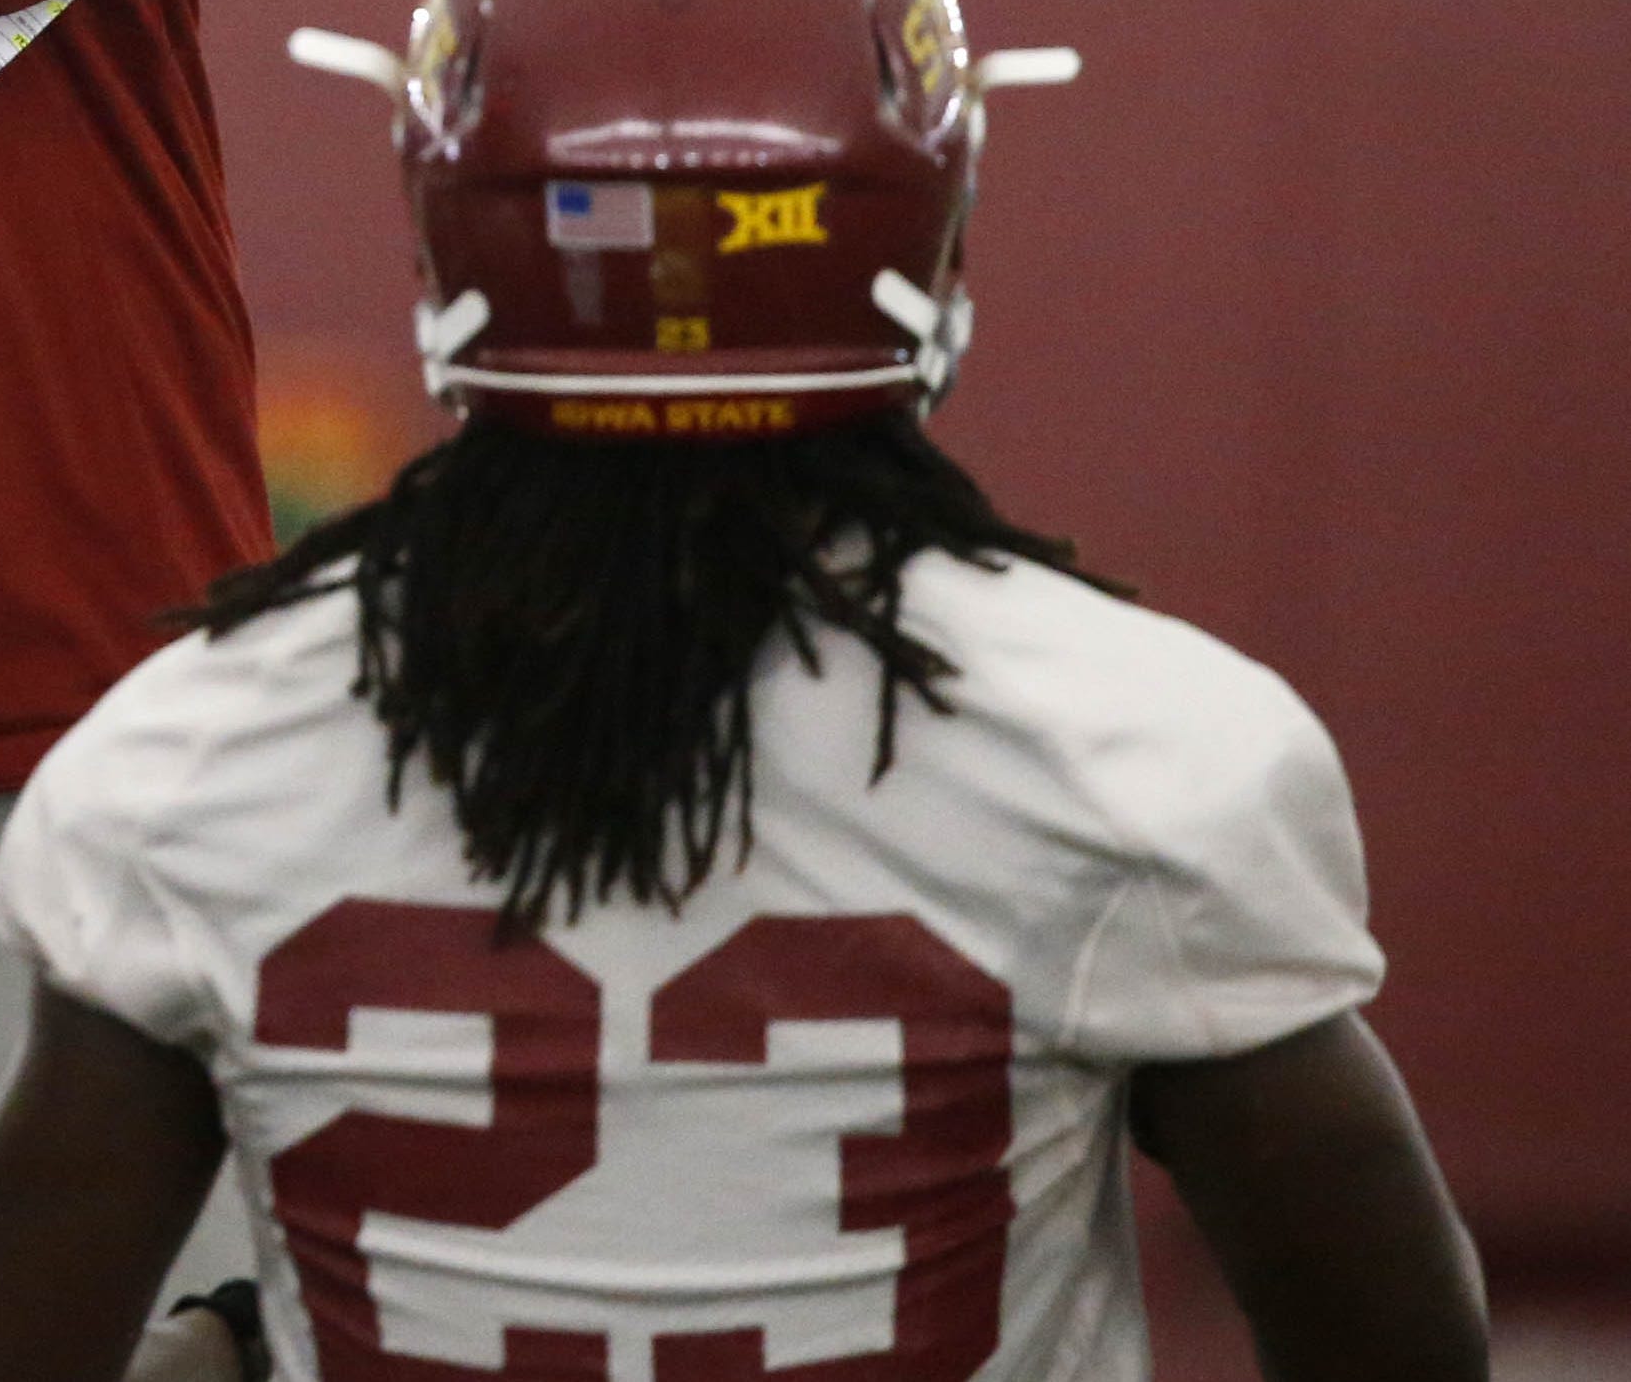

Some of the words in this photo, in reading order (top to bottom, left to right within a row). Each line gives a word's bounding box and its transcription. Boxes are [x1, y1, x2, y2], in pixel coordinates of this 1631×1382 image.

[718, 182, 828, 254] XII
[665, 399, 795, 430] STATE
[253, 896, 1015, 1382] 23
